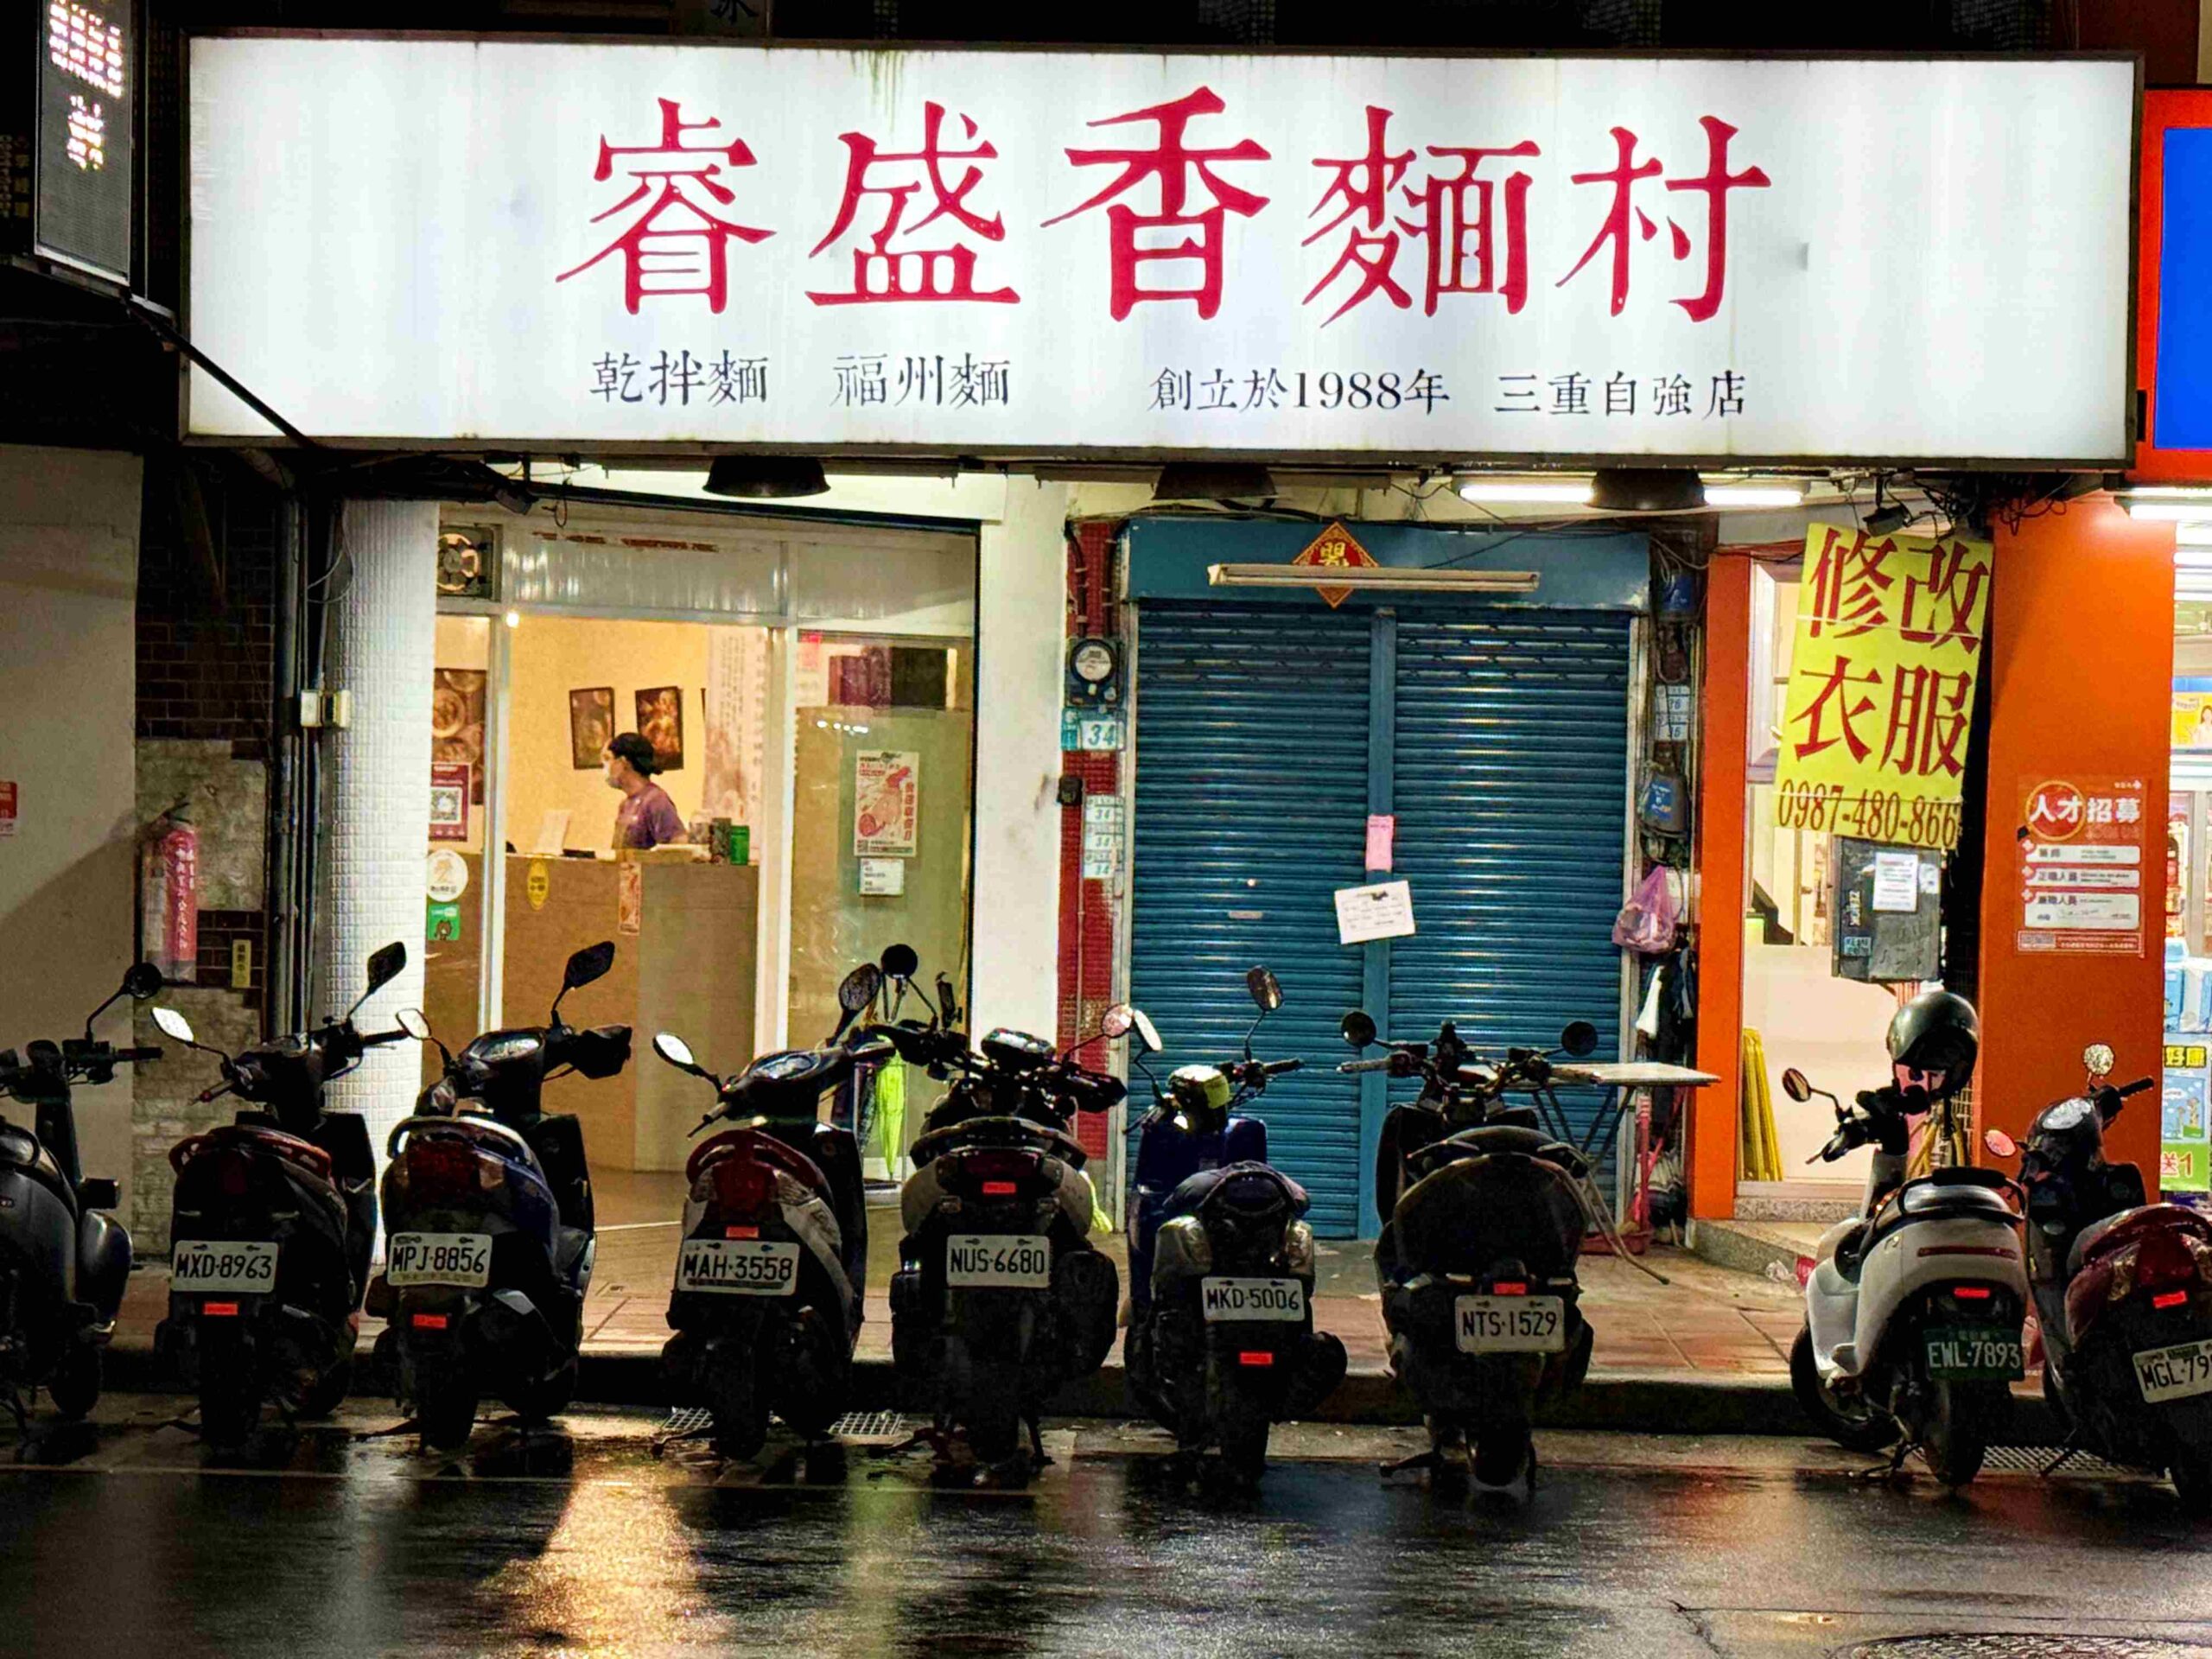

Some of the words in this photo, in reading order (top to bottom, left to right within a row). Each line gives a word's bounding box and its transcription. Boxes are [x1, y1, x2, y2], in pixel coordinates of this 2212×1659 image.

[556, 86, 1771, 327] 睿盛香麵村
[590, 349, 768, 406] 乾拌麵
[830, 353, 1009, 406] 福州麵
[1149, 366, 1450, 412] 創立於1988年
[1494, 370, 1746, 417] 三重自強店
[1809, 527, 1989, 654] 修改
[1088, 724, 1116, 746] 34
[1790, 655, 1972, 778] 衣服
[1778, 779, 1957, 847] 0987-480-866
[2029, 794, 2141, 823] 人才招募
